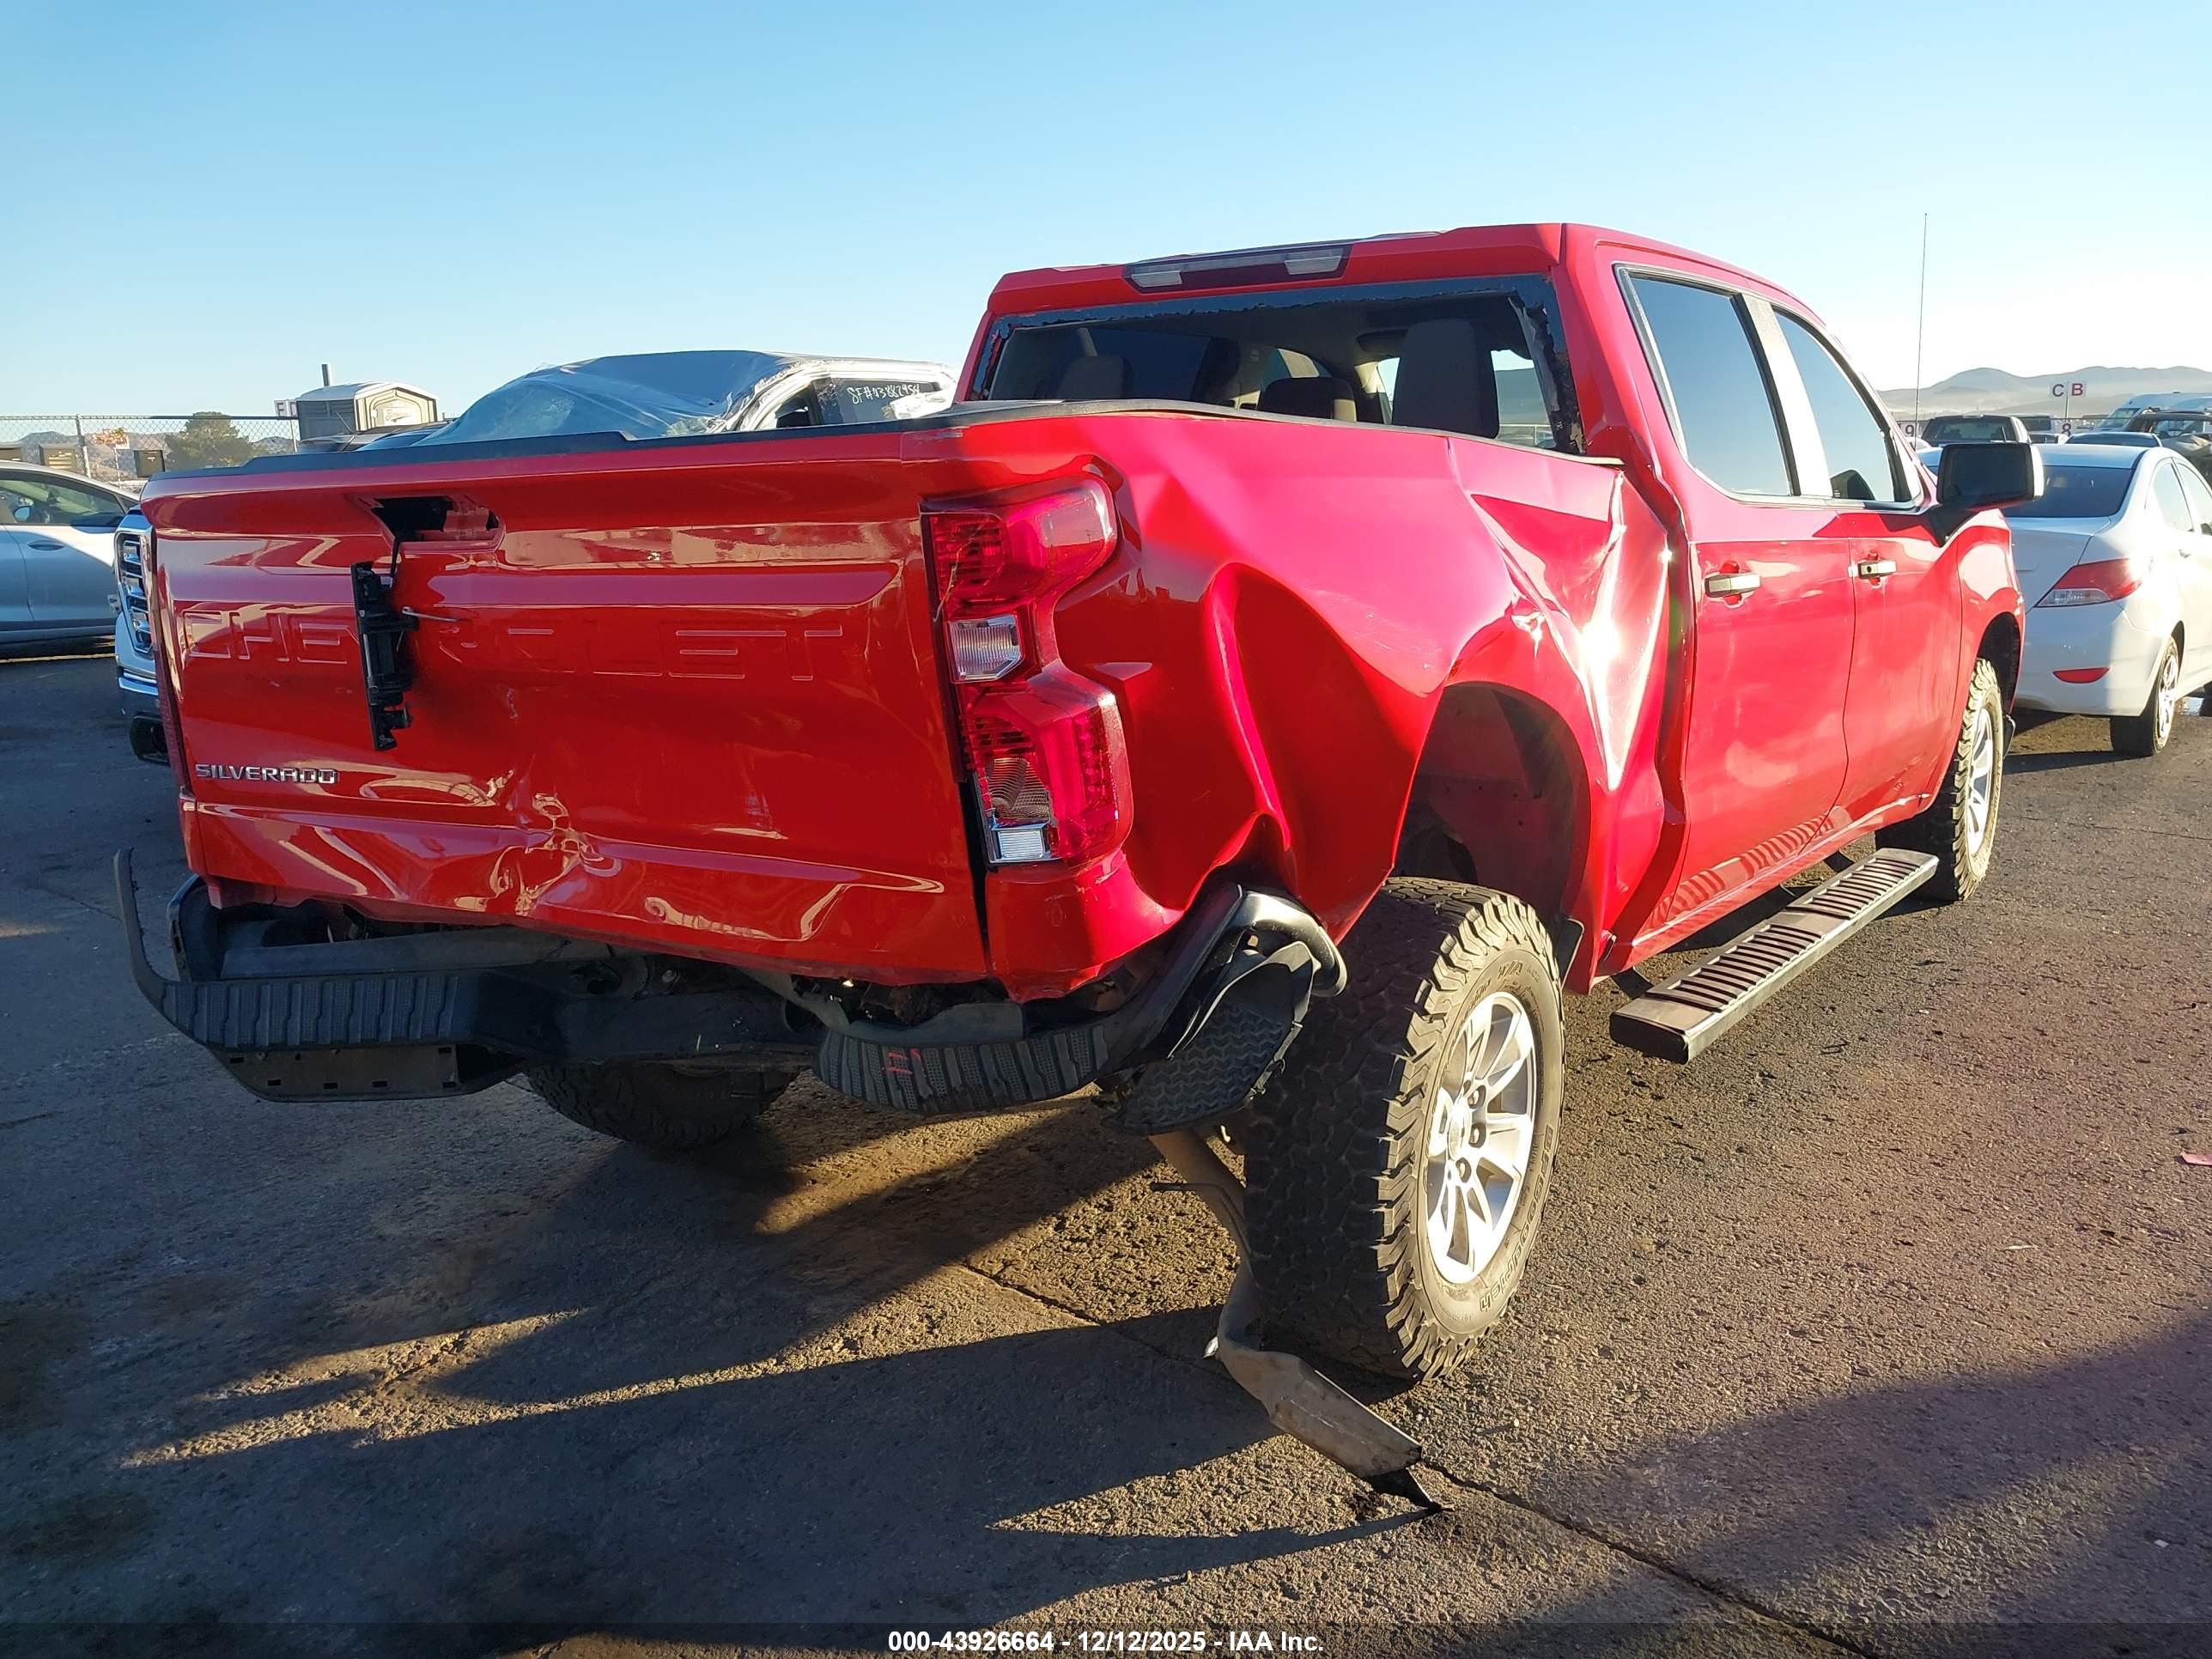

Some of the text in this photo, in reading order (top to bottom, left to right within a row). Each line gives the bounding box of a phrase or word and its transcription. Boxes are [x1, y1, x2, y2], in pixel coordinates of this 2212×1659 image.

[2052, 383, 2083, 398] C B
[2061, 422, 2072, 437] 8
[181, 609, 844, 682] CHEROLET
[195, 763, 337, 784] SILVERADO
